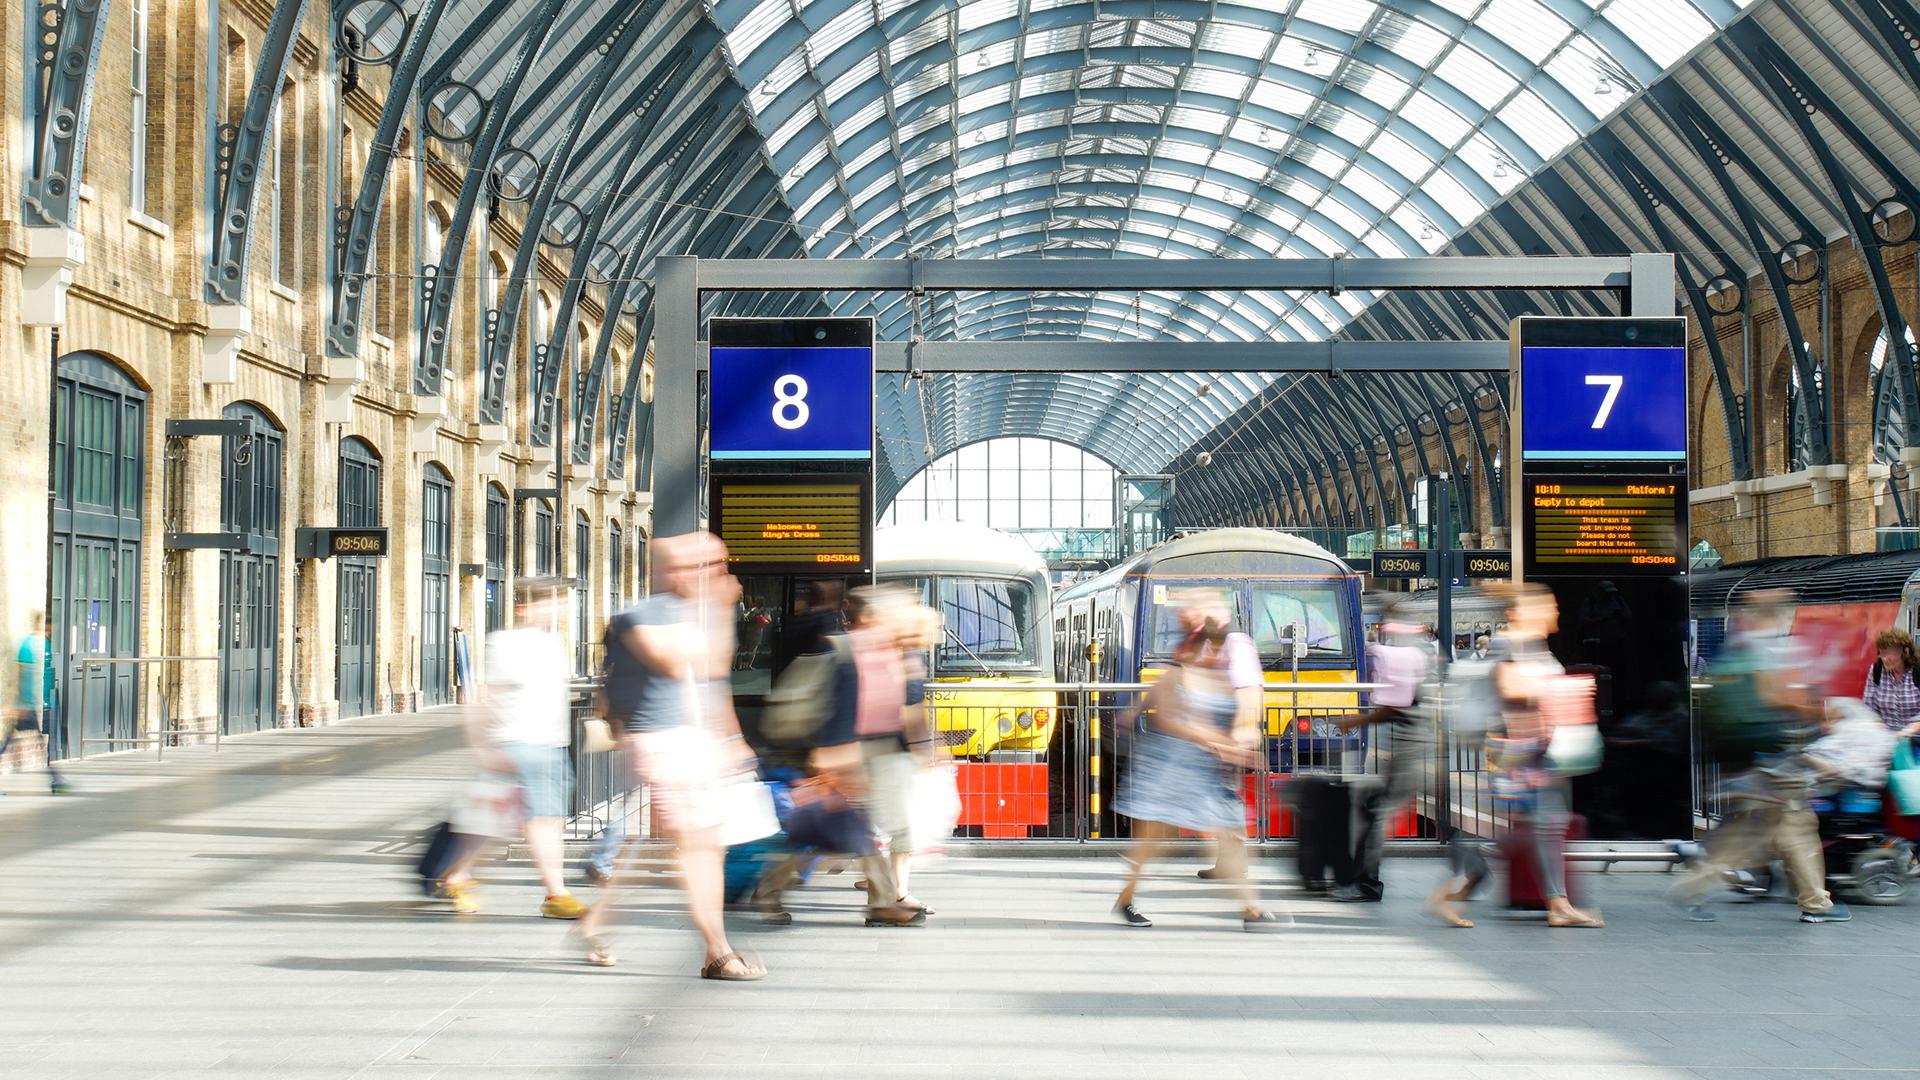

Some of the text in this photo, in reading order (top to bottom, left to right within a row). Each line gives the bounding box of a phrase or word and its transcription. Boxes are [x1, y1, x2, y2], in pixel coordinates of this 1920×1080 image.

[771, 374, 811, 430] 8
[1585, 375, 1623, 429] 7
[1535, 485, 1561, 495] 10:18
[1627, 485, 1675, 495] Platform 7
[1535, 497, 1606, 508] Empty to depot
[762, 531, 791, 539] King's
[816, 554, 861, 563] 09:50:46
[1631, 556, 1676, 564] 09:50:46
